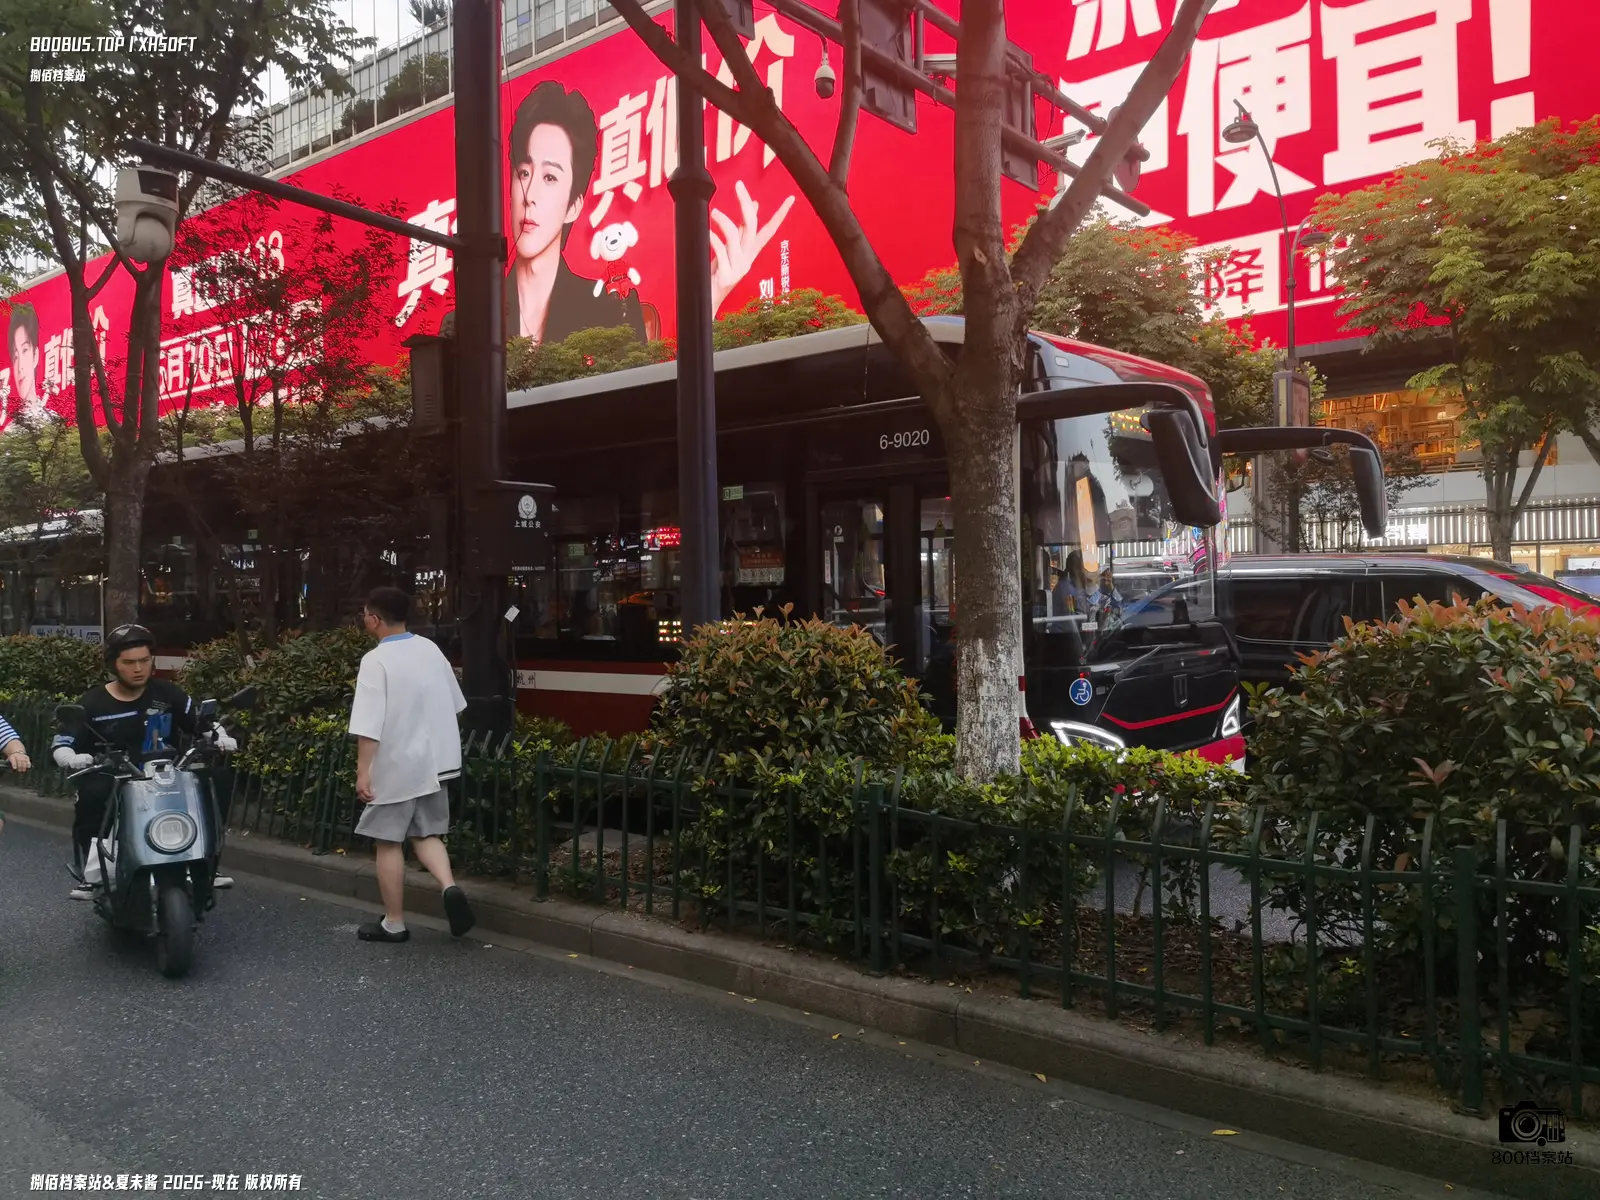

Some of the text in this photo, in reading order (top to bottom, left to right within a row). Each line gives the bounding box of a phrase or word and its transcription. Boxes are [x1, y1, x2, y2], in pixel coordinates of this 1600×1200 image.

[879, 430, 930, 450] 6-9020
[514, 520, 541, 528] 上城公安
